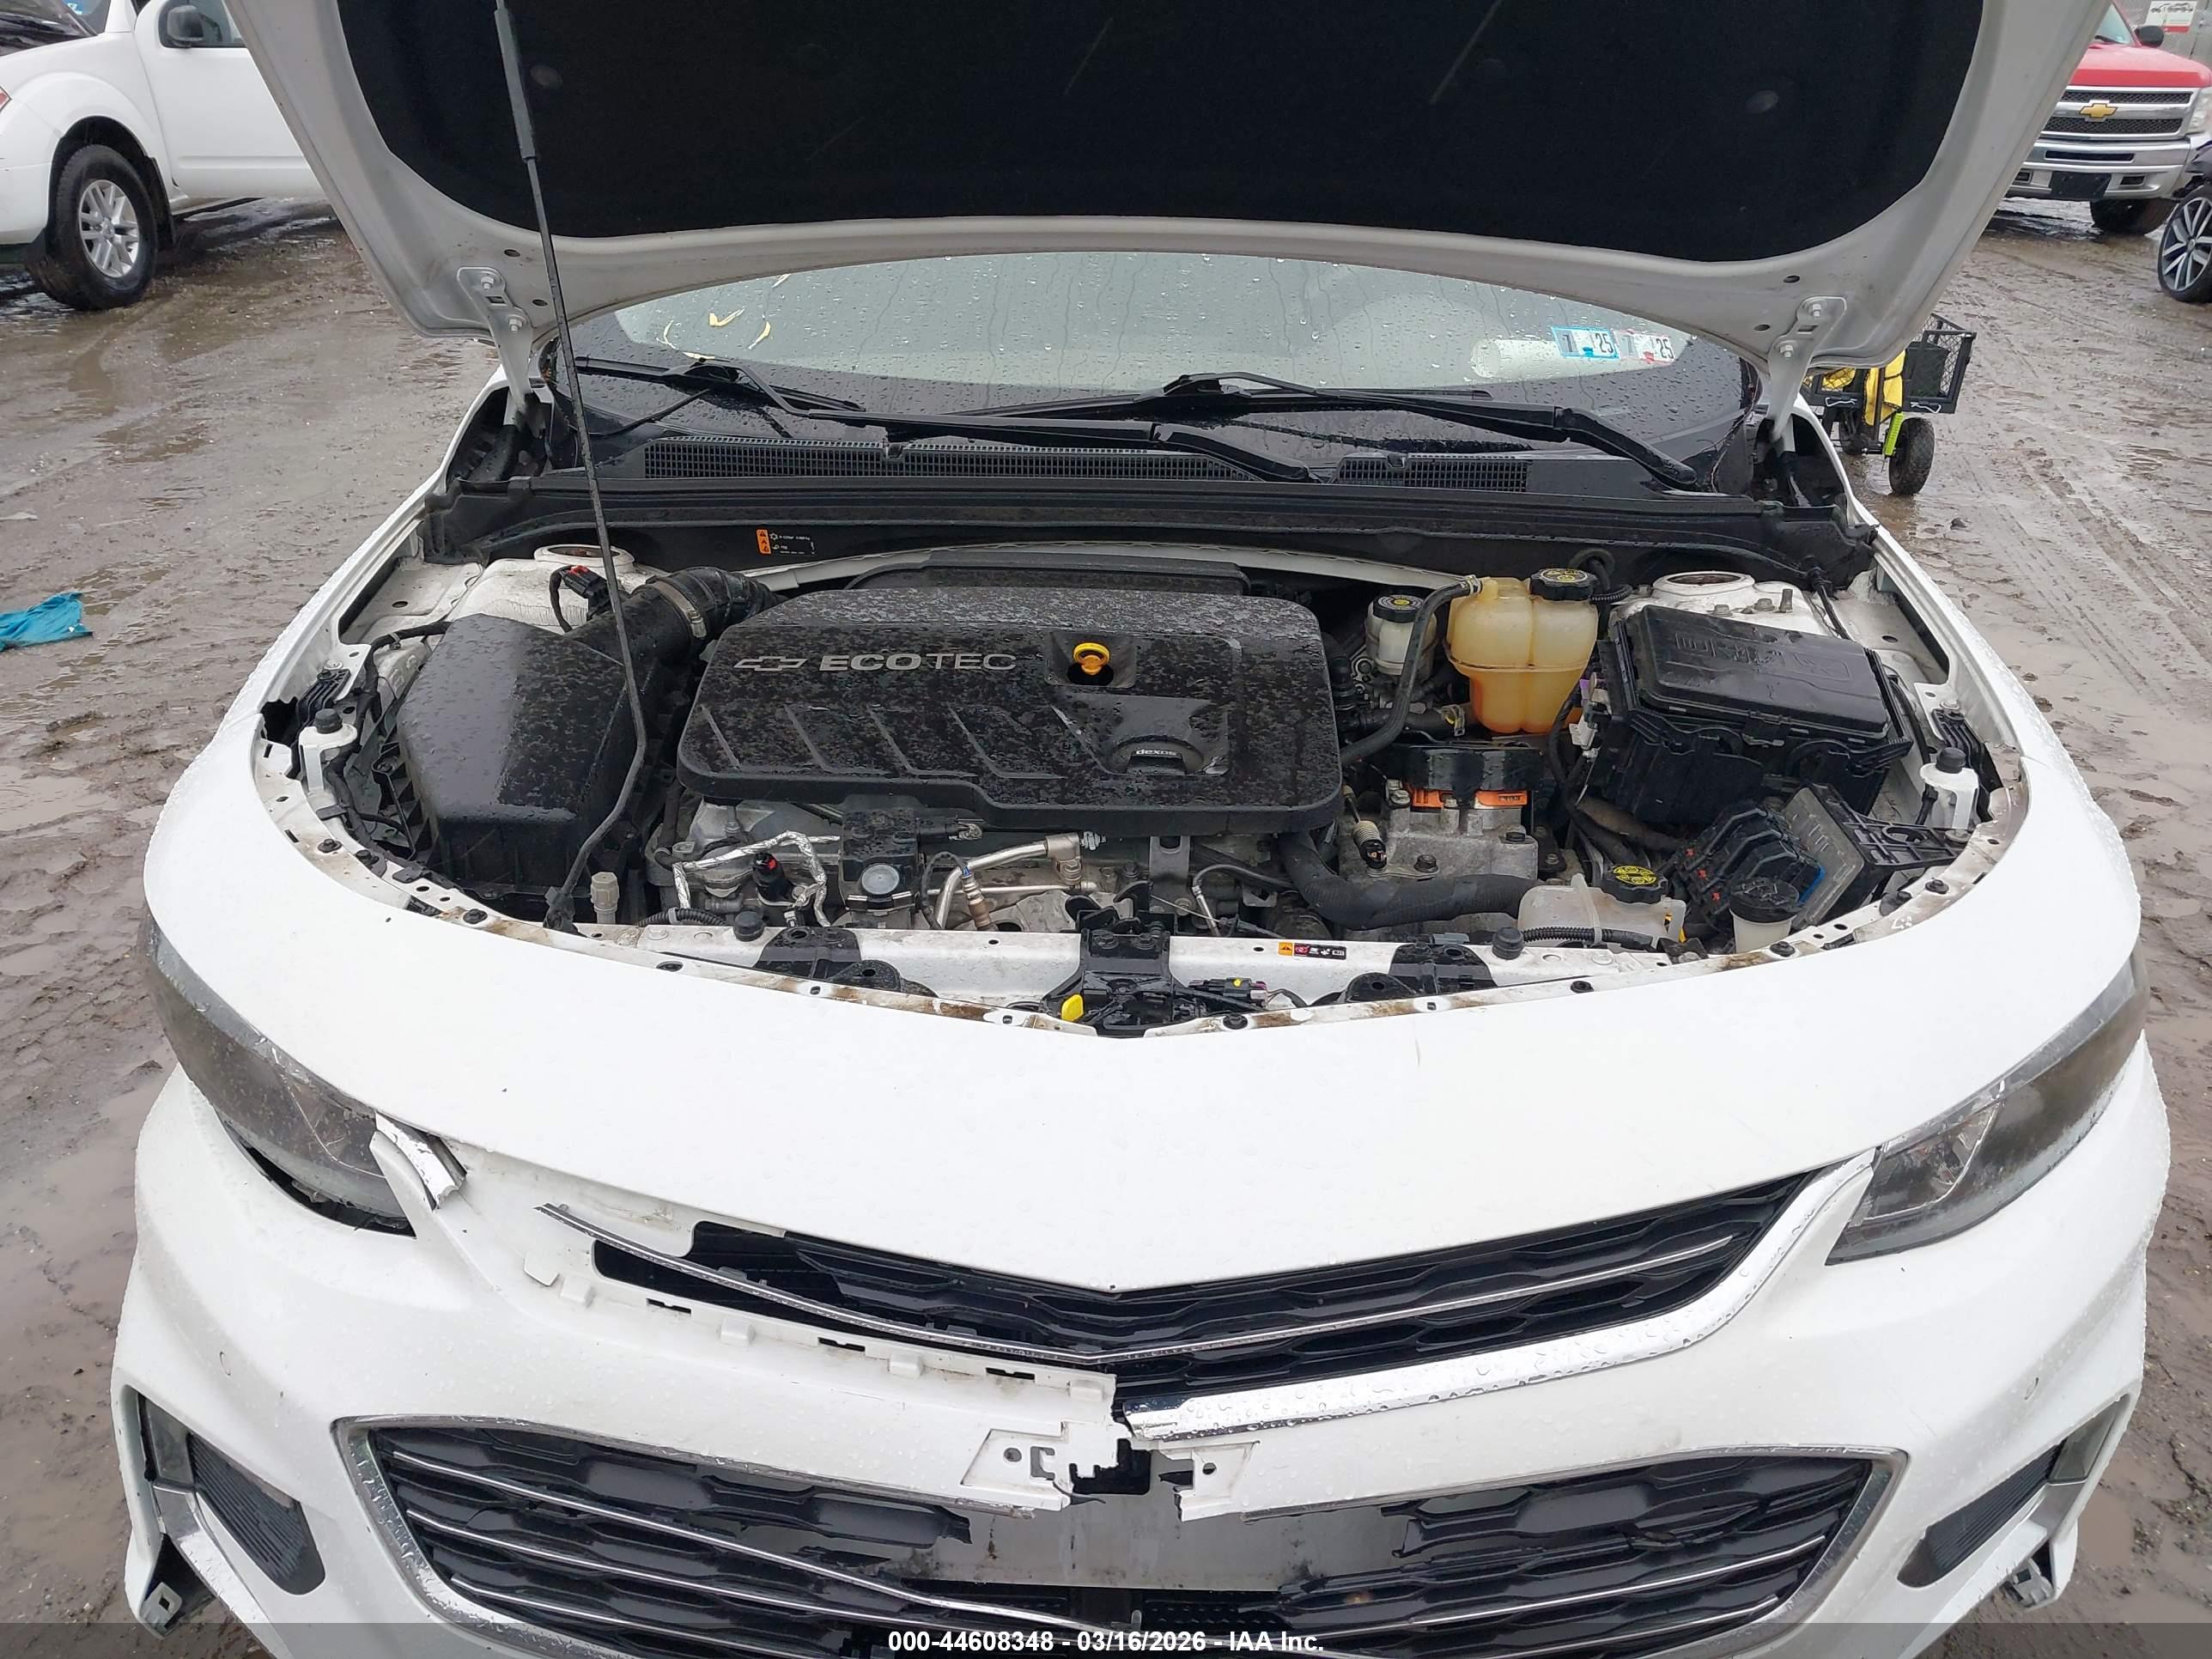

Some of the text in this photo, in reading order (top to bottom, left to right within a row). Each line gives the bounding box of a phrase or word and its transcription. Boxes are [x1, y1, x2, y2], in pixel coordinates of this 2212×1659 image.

[1595, 332, 1614, 353] 25
[1656, 337, 1674, 359] 25
[819, 653, 1018, 672] ECOTEC
